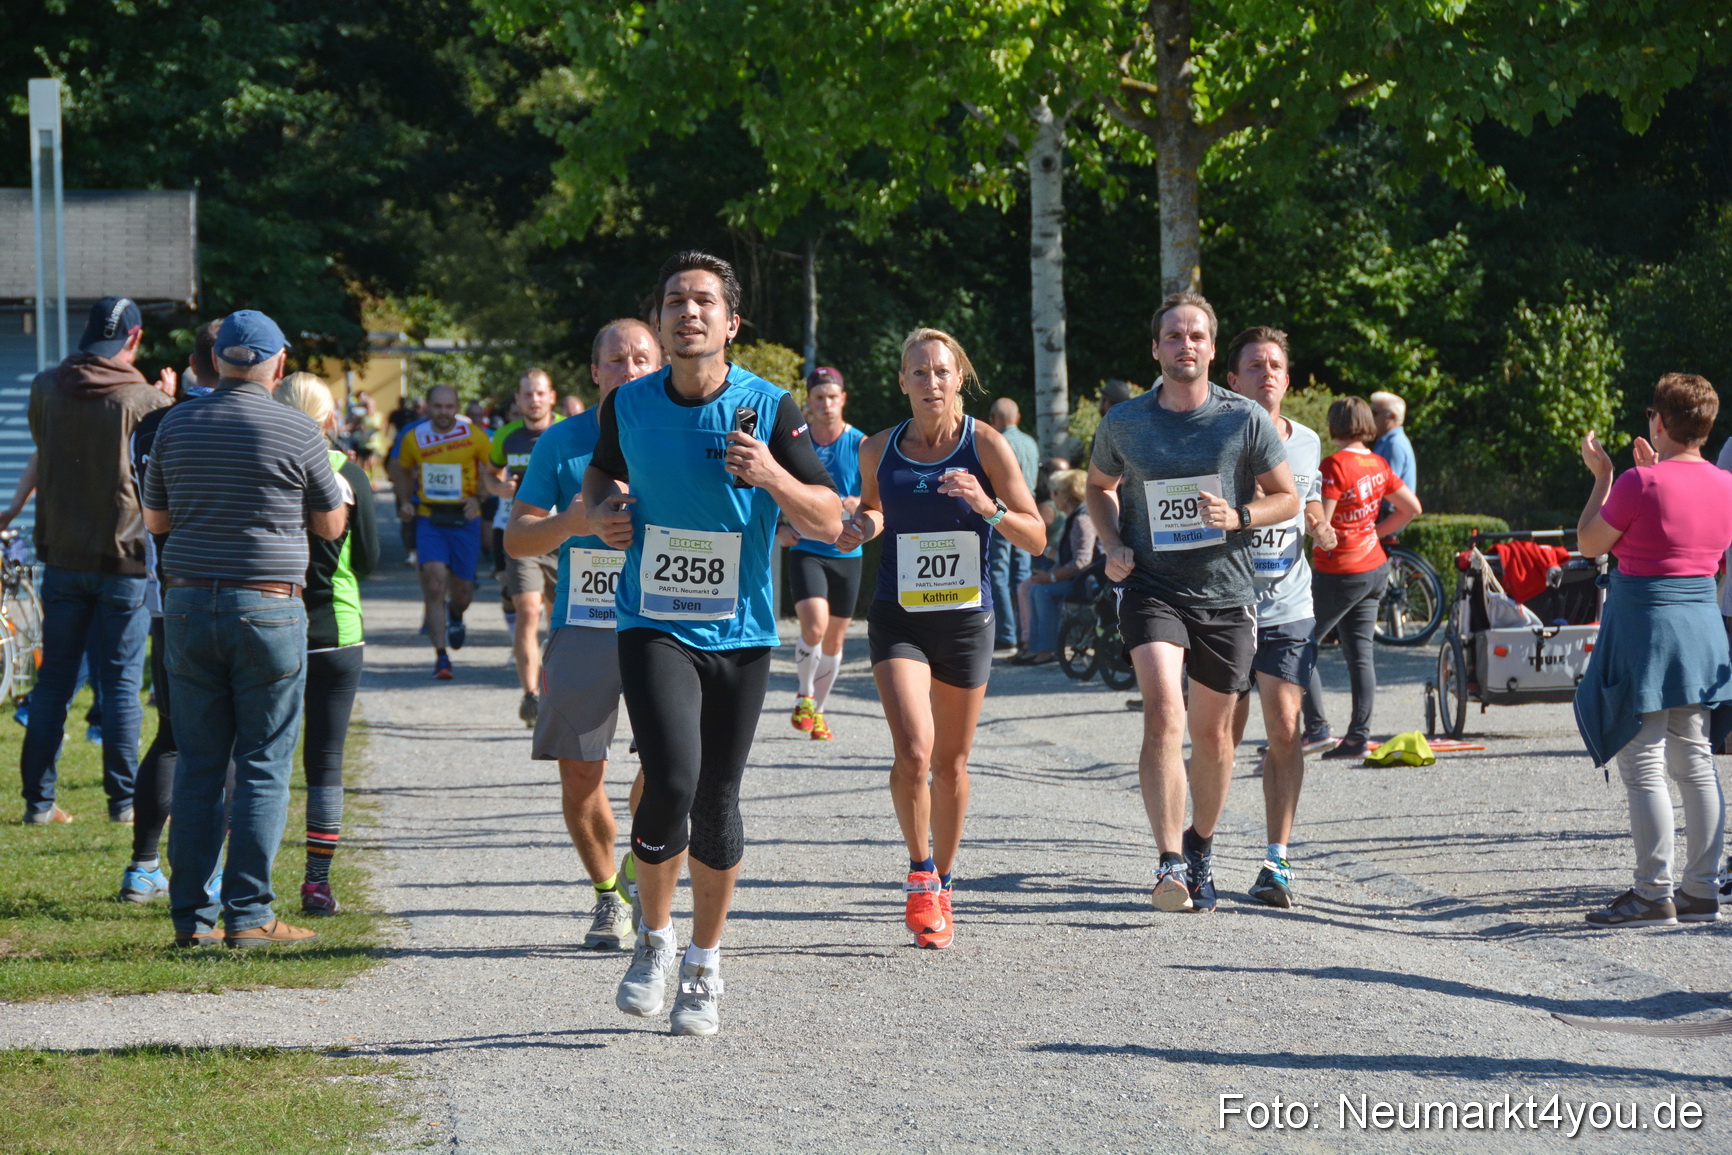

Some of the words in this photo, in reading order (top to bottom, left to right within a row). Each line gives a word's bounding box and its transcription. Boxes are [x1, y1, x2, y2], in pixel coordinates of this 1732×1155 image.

[427, 472, 454, 485] 2421
[1294, 474, 1309, 484] OCK
[1166, 483, 1199, 494] BOCK
[1158, 497, 1204, 521] 259
[1173, 531, 1203, 542] Martin
[1251, 528, 1286, 549] 547
[668, 537, 713, 551] BOCK
[920, 539, 955, 549] BOCK
[592, 556, 626, 565] BOCK
[916, 553, 960, 579] 207
[1254, 560, 1280, 569] orsten
[654, 553, 725, 585] 2358
[581, 570, 620, 595] 260
[658, 585, 680, 593] PARTL
[680, 587, 710, 595] Neumarkt
[922, 591, 958, 603] Kathrin
[672, 598, 702, 611] Sven
[588, 607, 618, 620] Steph
[641, 841, 666, 852] BODY
